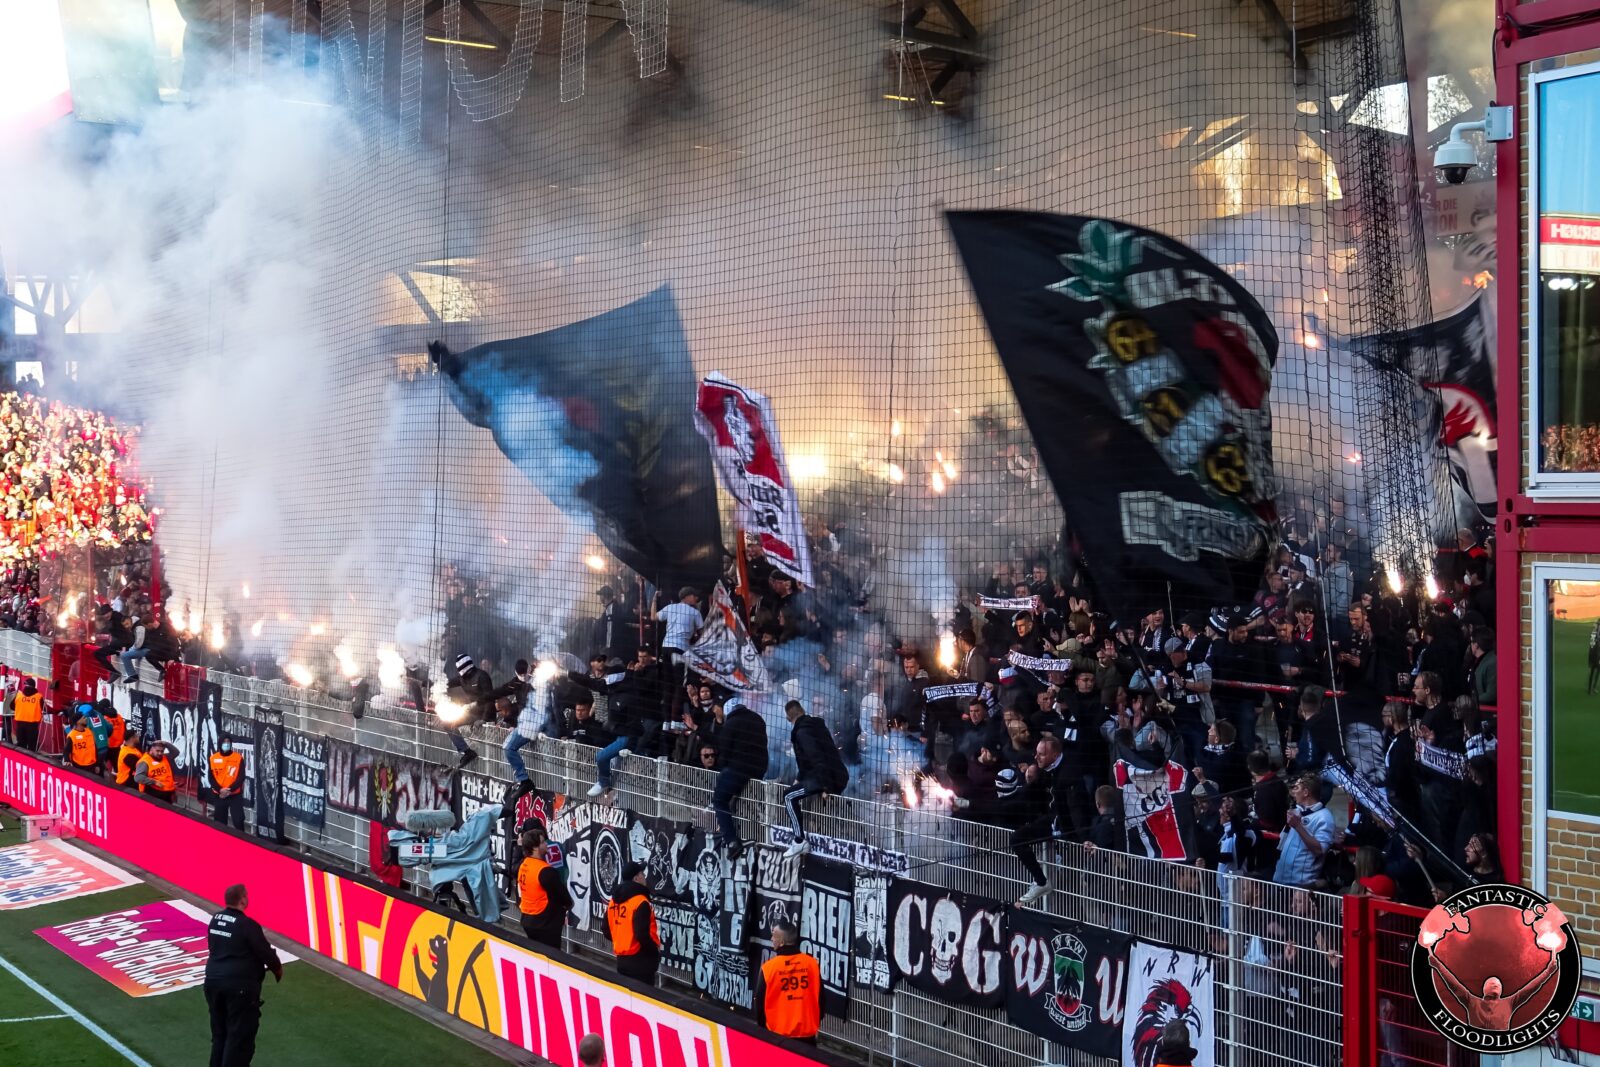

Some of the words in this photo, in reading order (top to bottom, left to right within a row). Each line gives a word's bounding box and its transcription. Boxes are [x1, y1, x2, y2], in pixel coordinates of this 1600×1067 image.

[73, 741, 87, 750] 152
[151, 767, 167, 778] 286
[3, 757, 36, 808] ALTEN
[40, 766, 107, 840] FÖRSTEREI
[592, 804, 628, 829] RAGAZZI
[801, 887, 850, 953] RIED
[780, 975, 809, 992] 295
